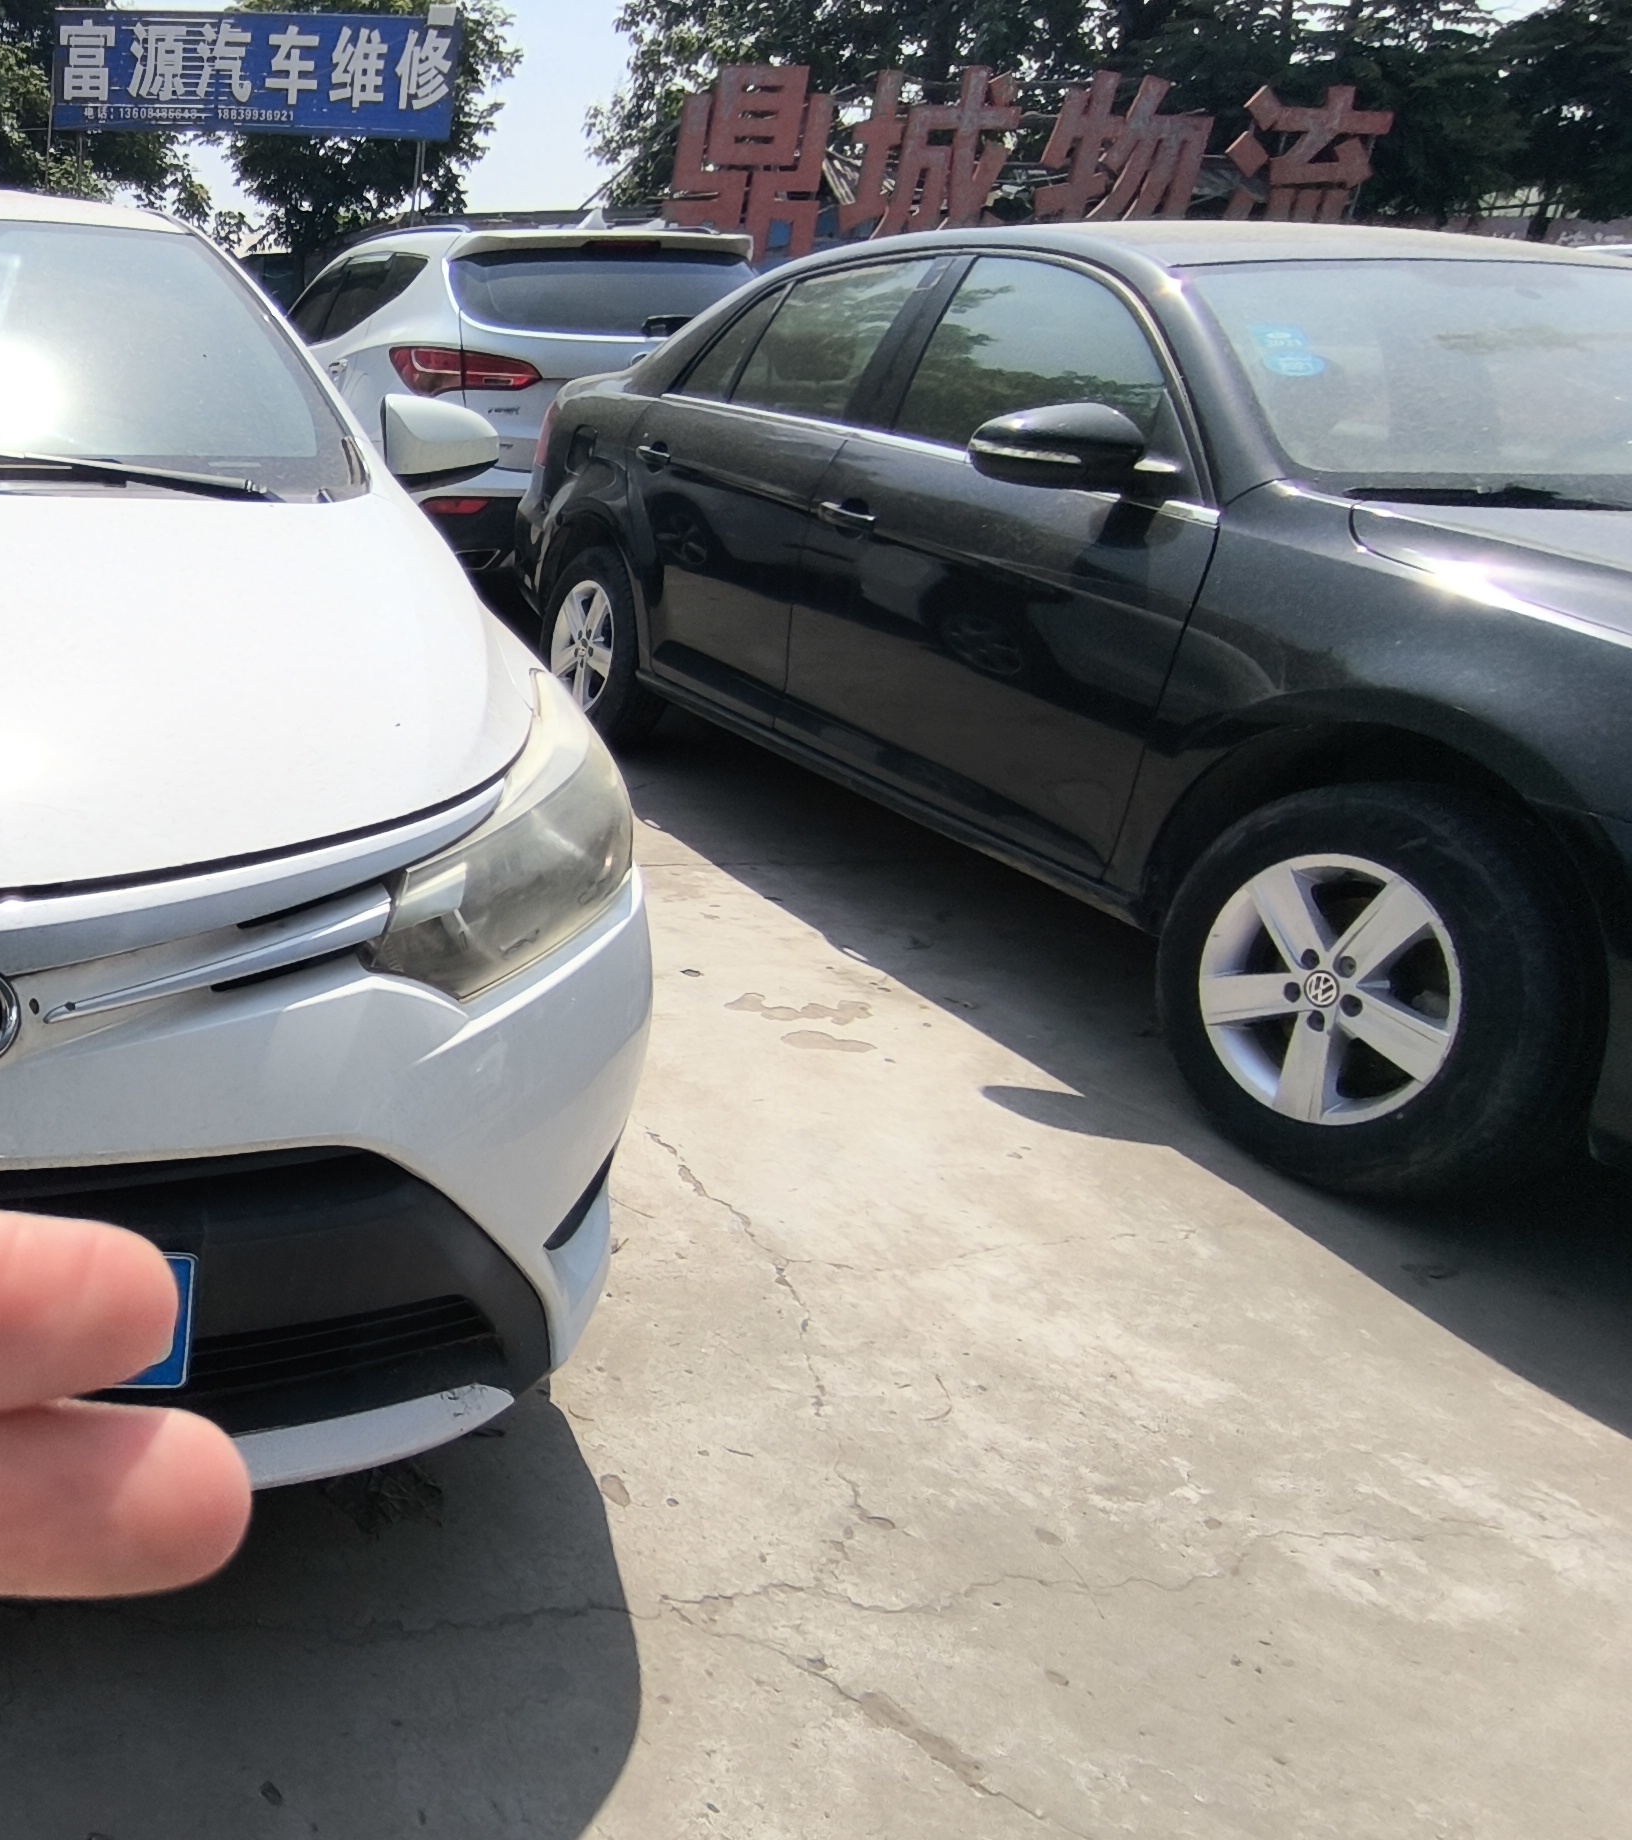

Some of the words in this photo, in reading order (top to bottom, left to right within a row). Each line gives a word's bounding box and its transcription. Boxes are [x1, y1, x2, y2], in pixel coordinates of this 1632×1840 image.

[59, 19, 452, 111] 富源汽车维修
